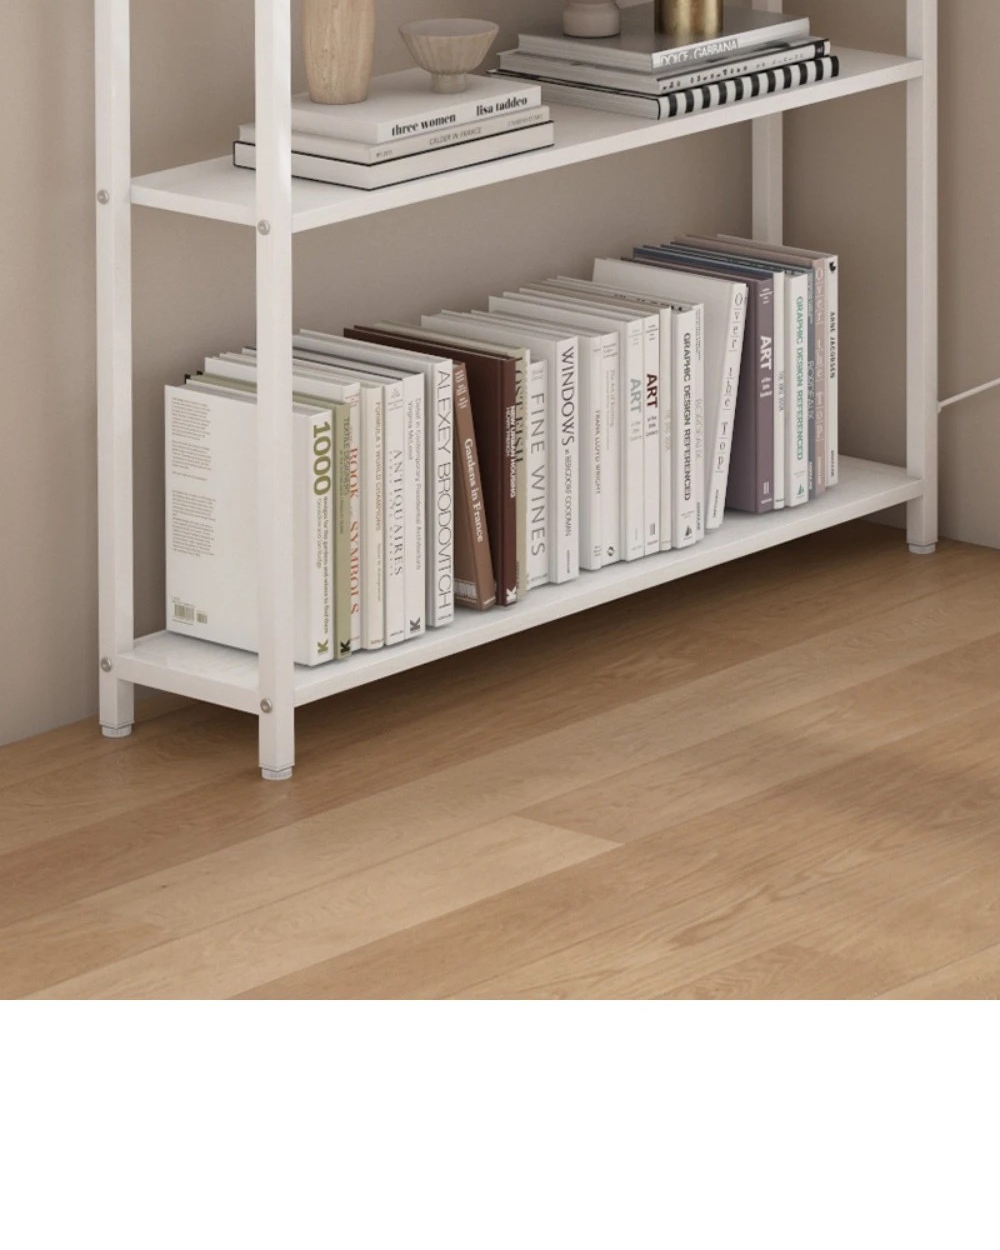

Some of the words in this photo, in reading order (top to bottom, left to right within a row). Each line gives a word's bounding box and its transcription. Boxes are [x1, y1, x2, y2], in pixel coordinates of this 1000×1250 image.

[693, 40, 738, 60] GABBANA
[392, 124, 419, 137] three
[421, 113, 456, 130] women
[476, 105, 493, 117] lisa
[496, 96, 527, 112] taddeo
[796, 296, 804, 345] GRAPHIC
[683, 332, 691, 382] GRAPHIC
[760, 335, 772, 370] ART
[796, 347, 804, 387] DESIGN
[437, 371, 451, 454] ALEXEY
[561, 346, 575, 446] WINDOWS
[630, 378, 642, 412] ART
[646, 373, 658, 408] ART
[683, 385, 691, 426] DESIGN
[531, 393, 545, 454] FINE
[313, 421, 331, 496] 1000
[350, 447, 358, 498] BOOK
[464, 438, 477, 487] Gardens
[683, 428, 691, 501] REFERENCED
[393, 450, 403, 576] ANTIQUAIRES
[470, 487, 477, 502] in
[531, 464, 545, 556] WINES
[437, 461, 452, 610] BRODOVITCH
[473, 501, 484, 543] France
[350, 521, 359, 614] SYMBOLS
